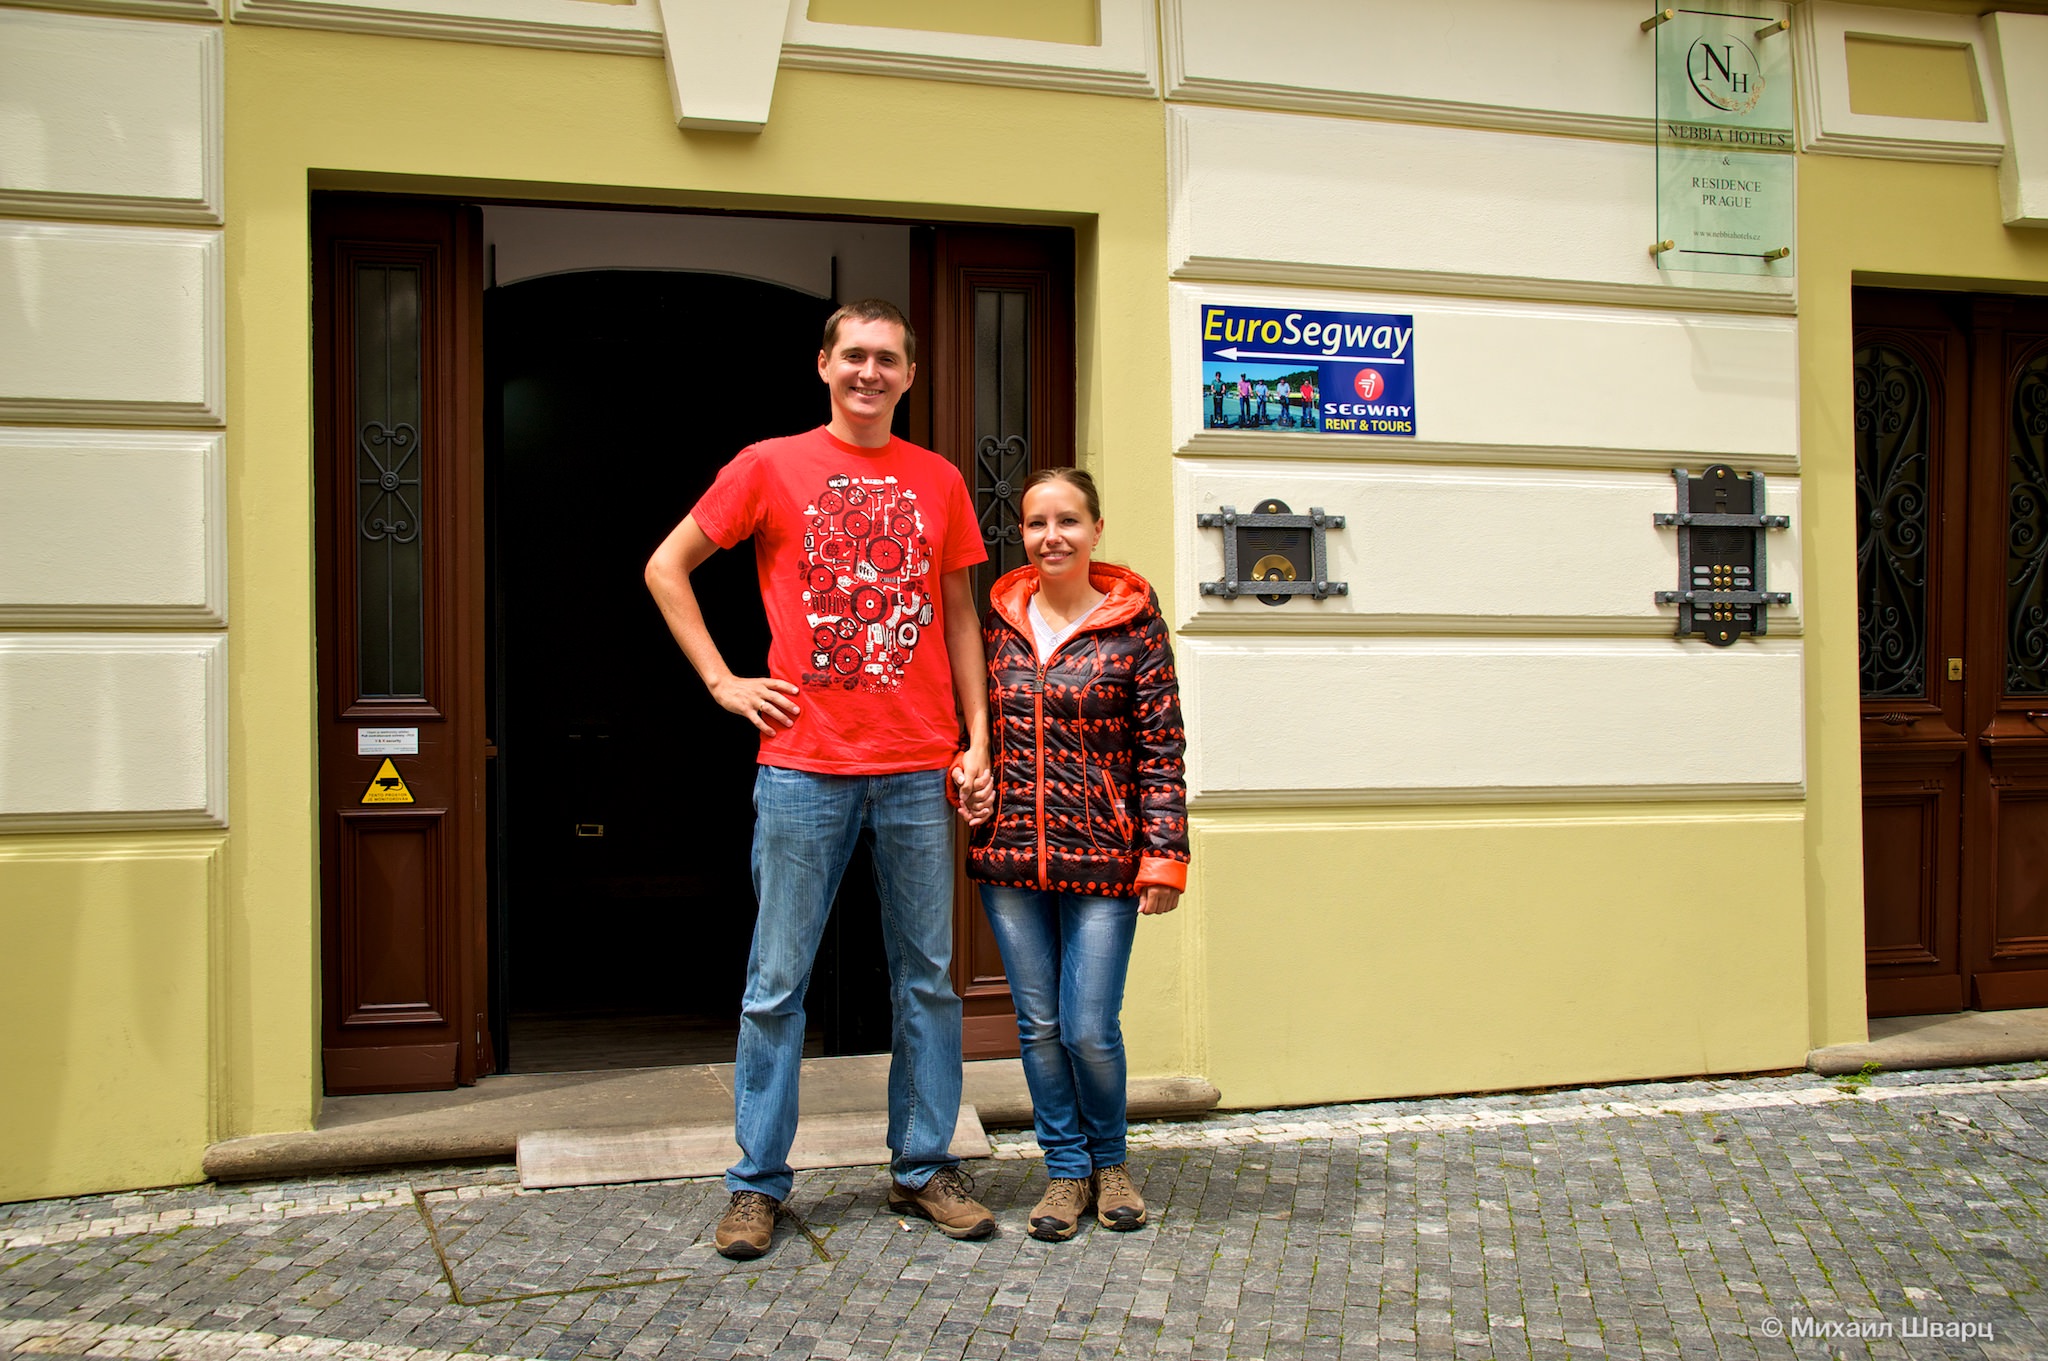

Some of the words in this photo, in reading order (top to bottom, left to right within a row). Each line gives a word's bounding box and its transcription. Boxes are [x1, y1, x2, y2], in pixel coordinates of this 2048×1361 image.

[1668, 124, 1723, 142] NEBBIA
[1729, 129, 1785, 147] HOTELS
[1722, 156, 1731, 166] &
[1692, 177, 1762, 193] RESIDENCE
[1702, 195, 1752, 209] PRAGUE
[1204, 309, 1413, 359] EuroSegway
[1324, 403, 1411, 418] SEGWAY
[1325, 419, 1357, 431] RENT
[1359, 420, 1369, 432] &
[1371, 420, 1412, 433] TOURS
